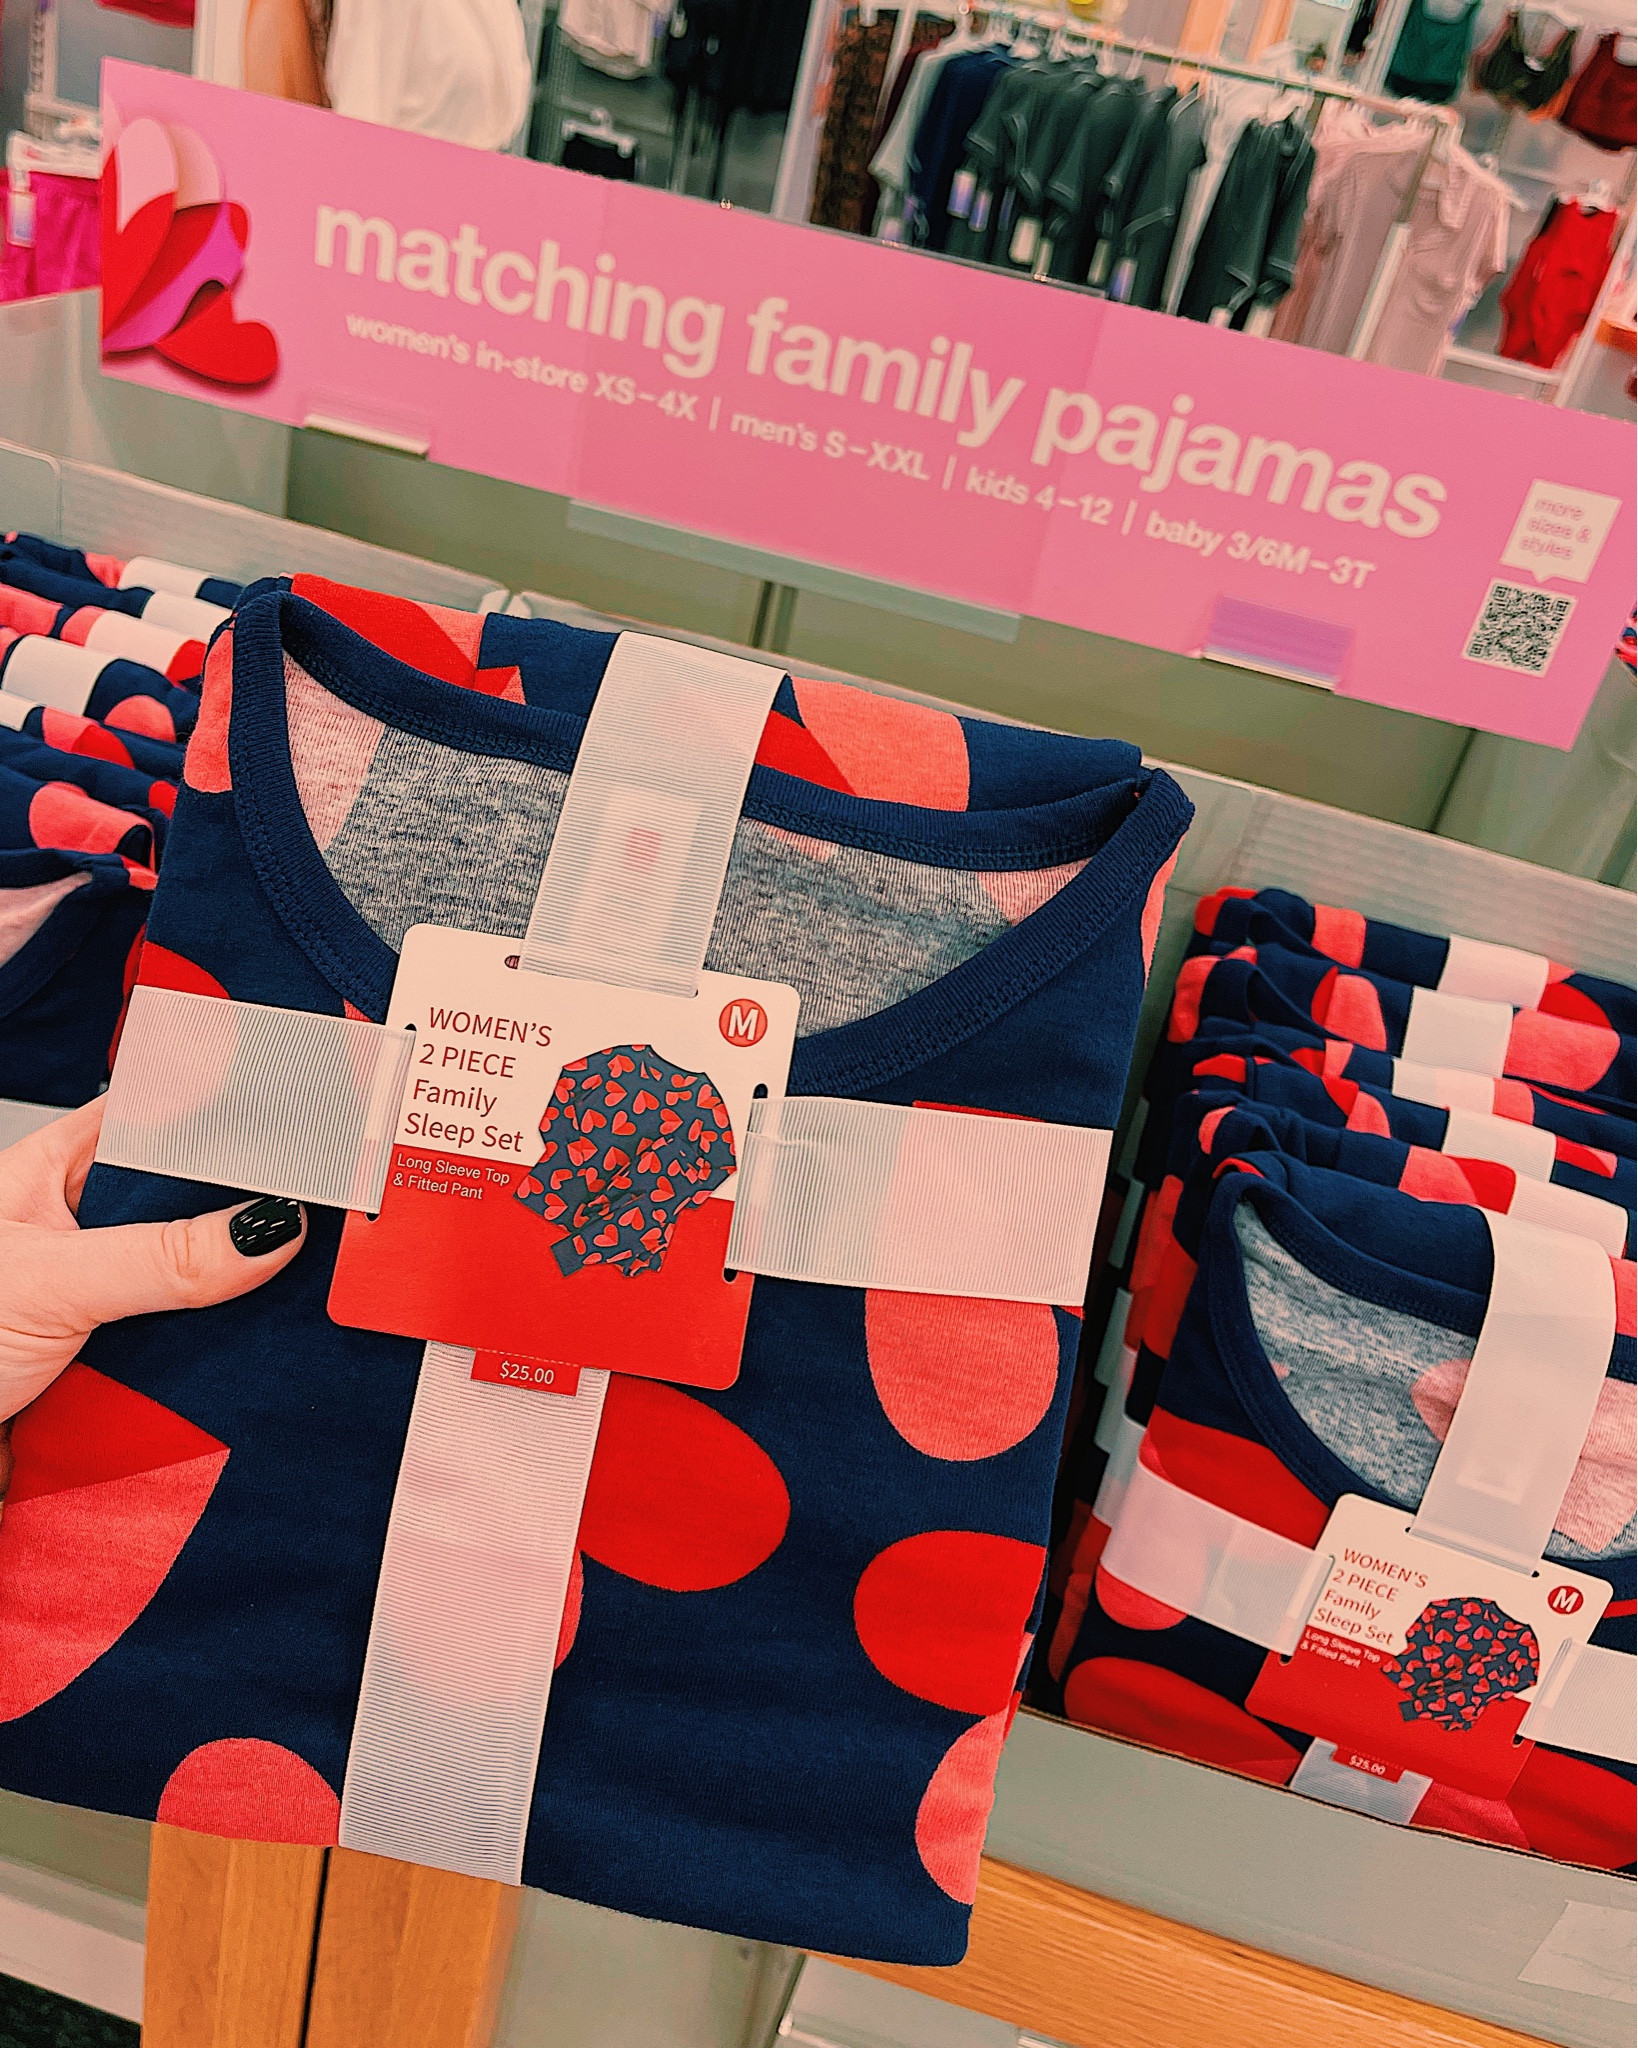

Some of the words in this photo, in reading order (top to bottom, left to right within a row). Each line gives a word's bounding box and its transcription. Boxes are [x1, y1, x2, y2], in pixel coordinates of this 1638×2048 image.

[314, 205, 724, 378] matching
[746, 297, 1025, 448] family
[1031, 386, 1447, 538] pajamas
[345, 314, 469, 365] women's
[476, 340, 588, 394] in-store
[730, 409, 817, 453] men's
[964, 465, 1028, 506] kids
[1145, 510, 1219, 558] baby
[1535, 499, 1584, 520] more
[1528, 516, 1573, 540] sizes
[1520, 536, 1573, 560] styles
[429, 1007, 553, 1047] WOMEN'S
[727, 1005, 759, 1041] M
[419, 1043, 435, 1066] 2
[441, 1046, 517, 1079] PIECE
[413, 1078, 498, 1118] Family
[404, 1112, 475, 1149] Sleep
[481, 1125, 524, 1153] Set
[393, 1173, 404, 1187] &
[408, 1175, 448, 1194] Fitted
[451, 1184, 483, 1200] Pant
[397, 1153, 432, 1173] Long
[435, 1160, 481, 1179] Sleeve
[485, 1167, 510, 1186] Top
[499, 1361, 555, 1386] $25.00
[1333, 1568, 1345, 1584] 2
[1347, 1573, 1399, 1602] PIECE
[1344, 1548, 1429, 1589] WOMEN'S
[1324, 1588, 1382, 1621] Family
[1551, 1588, 1576, 1612] M
[1314, 1606, 1362, 1636] Sleep
[1365, 1624, 1394, 1646] Set
[1300, 1640, 1309, 1651] &
[1310, 1643, 1339, 1660] Fitted
[1338, 1653, 1361, 1669] Pant
[1305, 1628, 1330, 1646] Long
[1330, 1637, 1361, 1656] Sleeve
[1363, 1647, 1381, 1664] Top
[1349, 1755, 1386, 1775] $25.00
